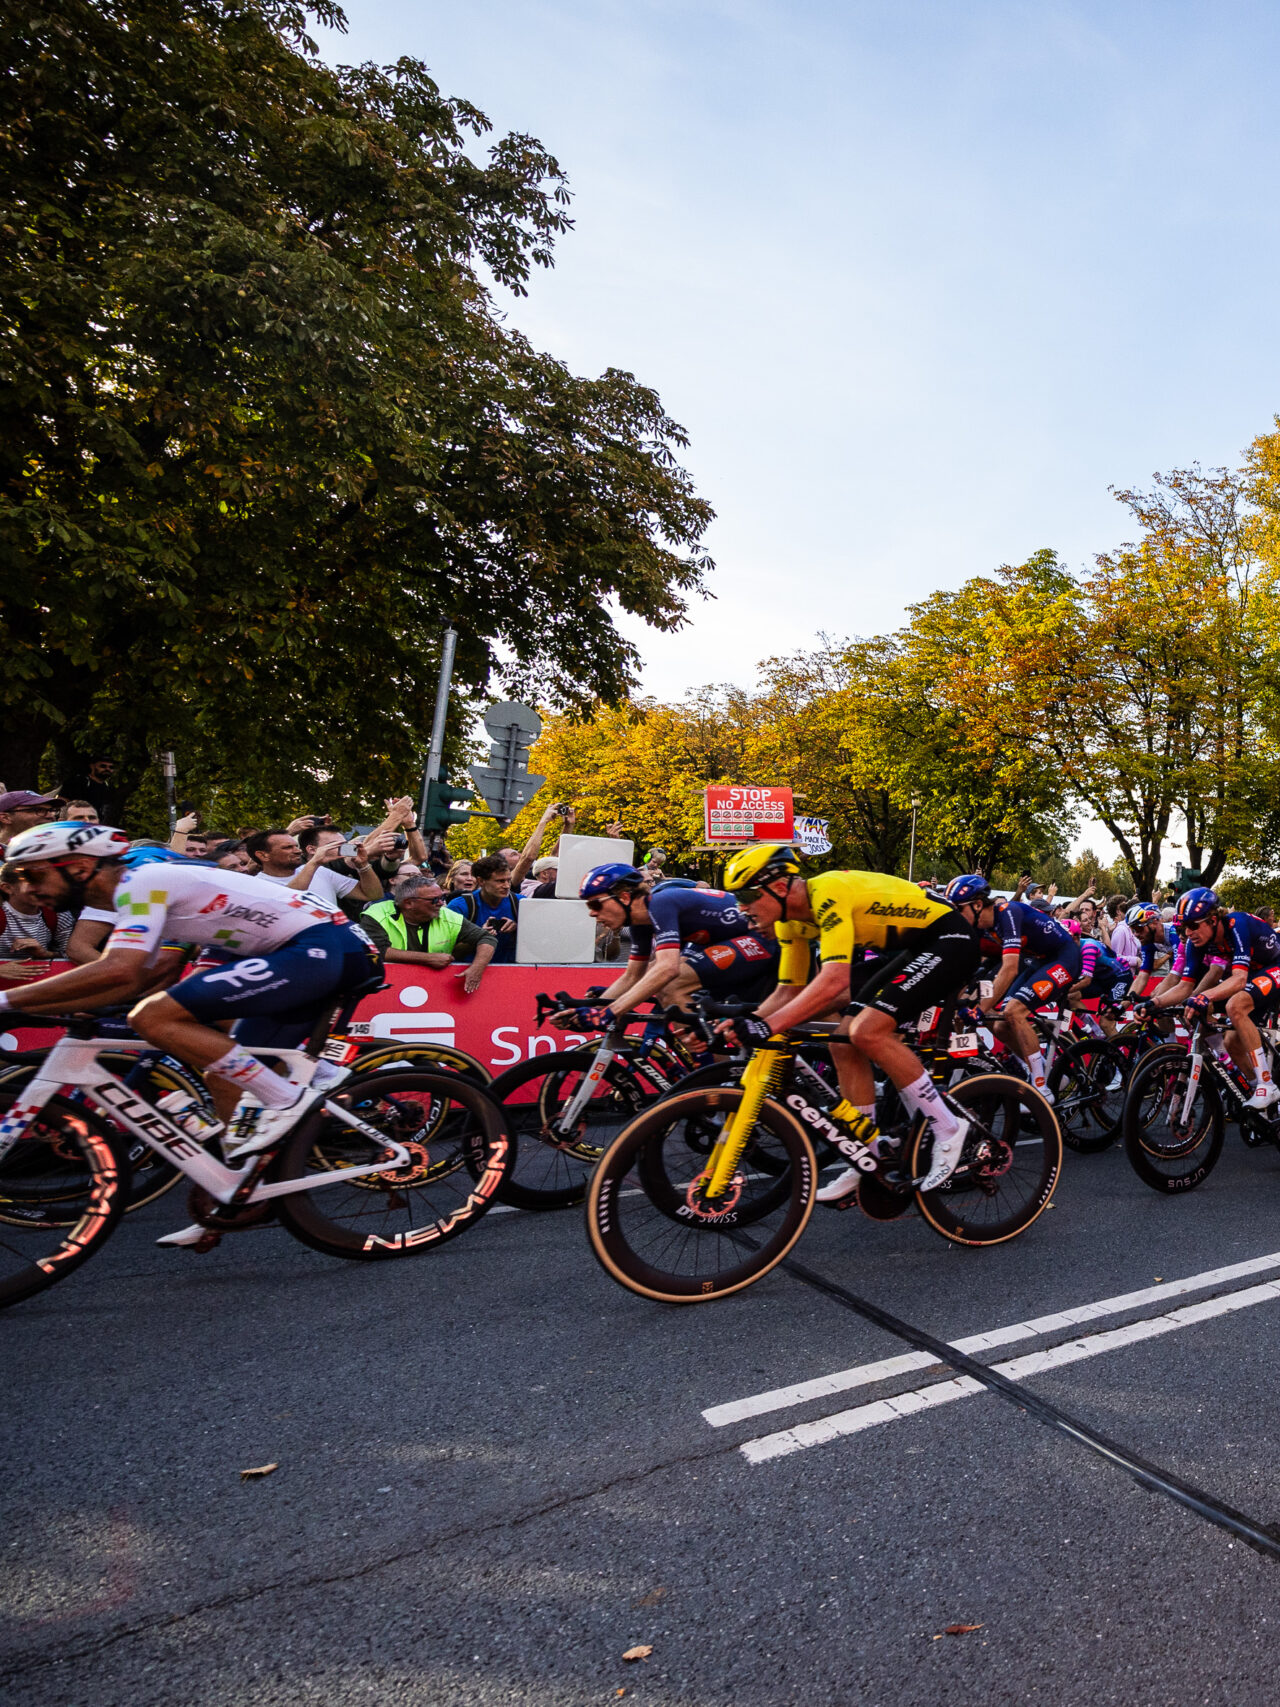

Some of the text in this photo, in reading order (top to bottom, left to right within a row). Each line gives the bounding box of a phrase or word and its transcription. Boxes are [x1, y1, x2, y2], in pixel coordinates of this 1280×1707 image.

[730, 788, 772, 801] STOP
[717, 800, 785, 810] NO ACCESS
[804, 817, 829, 837] MAX
[221, 903, 280, 928] VENDÉE
[864, 901, 931, 920] Rabobank
[902, 952, 934, 972] VISMA
[899, 972, 925, 991] lease
[956, 1036, 970, 1048] 102
[95, 1082, 202, 1160] CUBE
[786, 1094, 878, 1172] cervélo
[362, 1134, 508, 1251] NEWMEN
